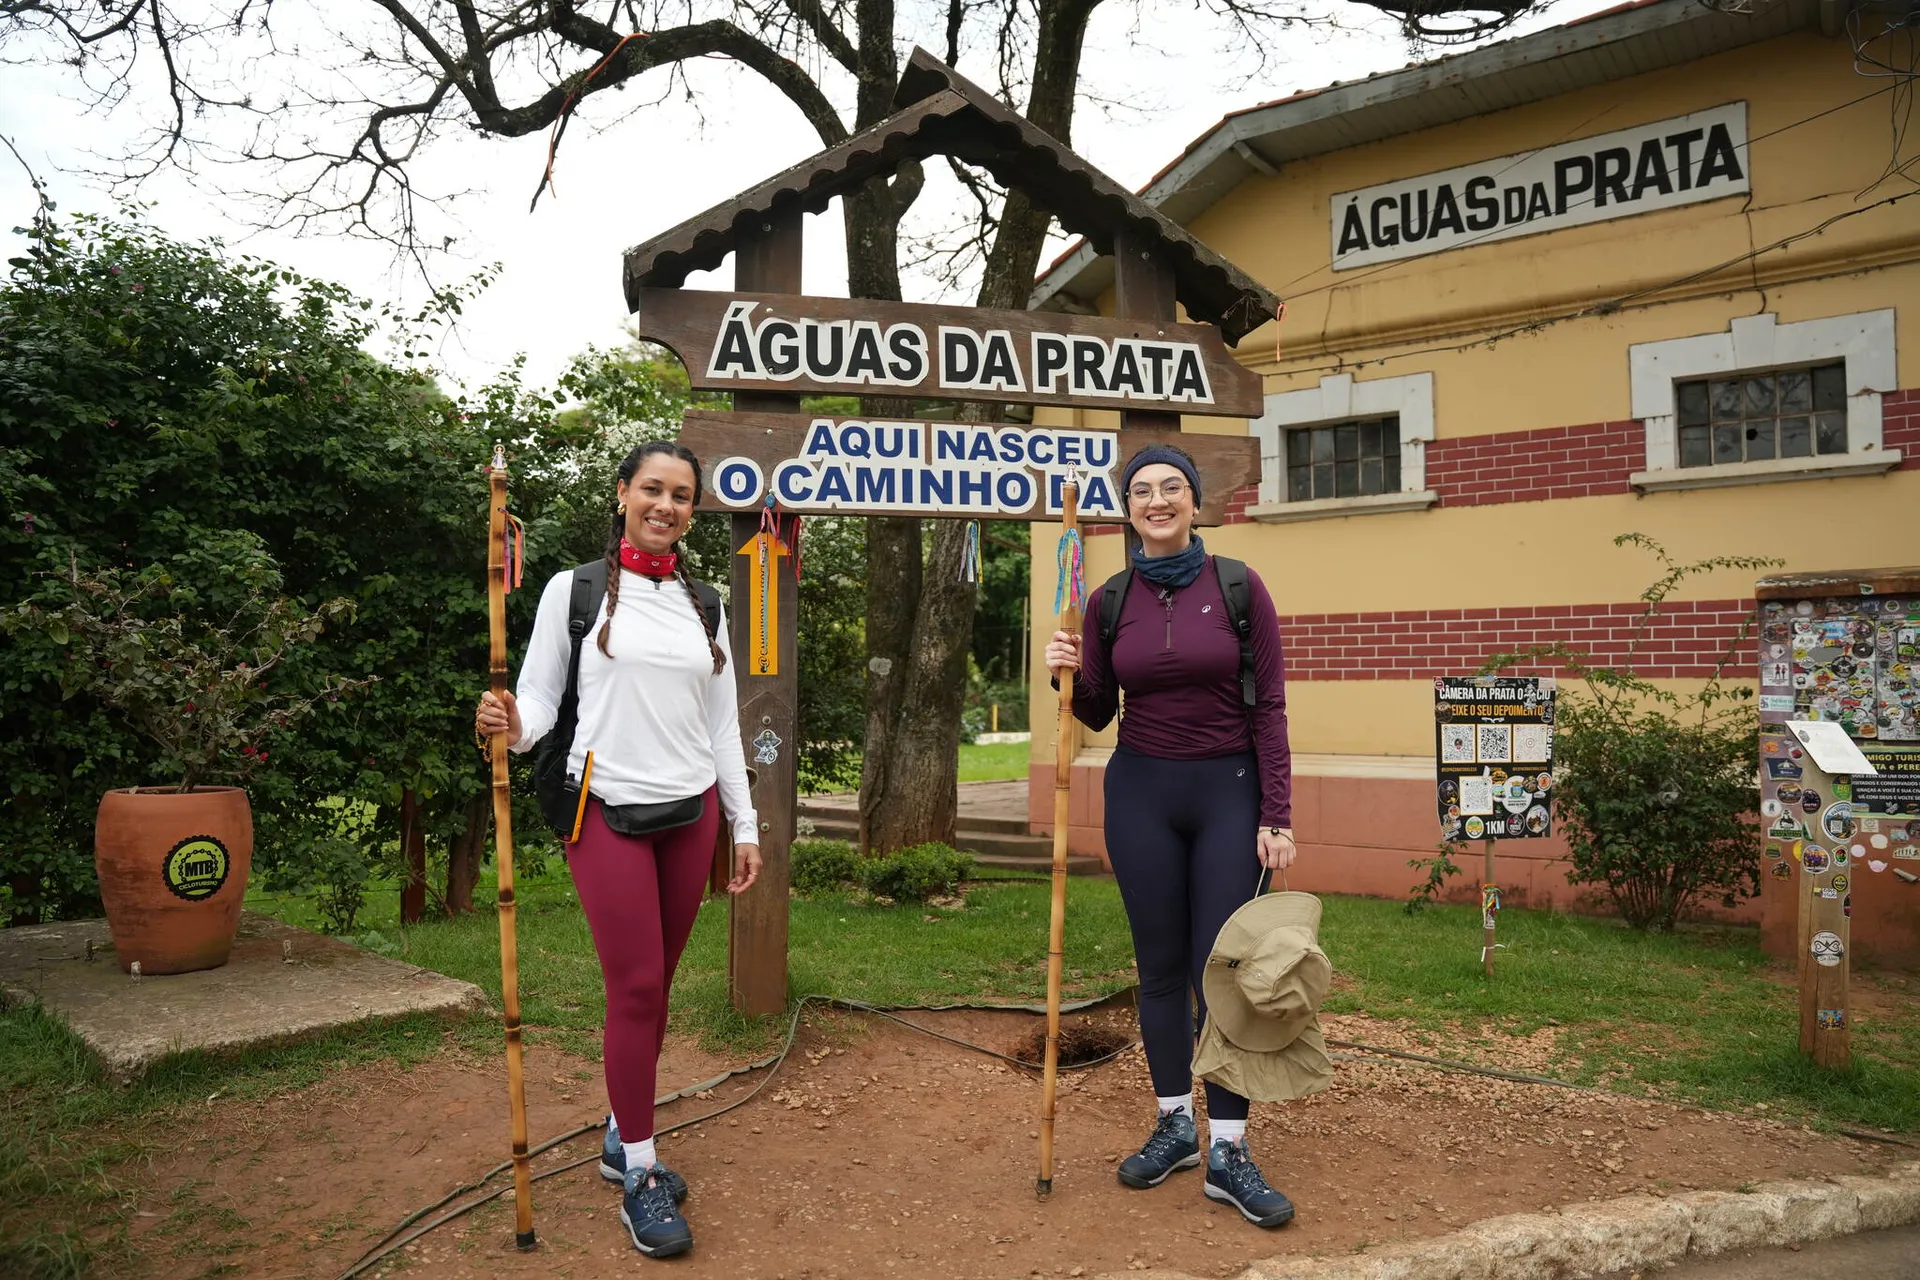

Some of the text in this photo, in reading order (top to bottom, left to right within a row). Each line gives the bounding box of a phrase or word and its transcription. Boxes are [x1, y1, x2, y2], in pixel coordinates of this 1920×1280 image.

[1336, 122, 1744, 257] ÁGUAS DA PRATA
[714, 304, 1209, 399] ÁGUAS DA PRATA
[808, 424, 1112, 466] AQUI NASCEU
[719, 463, 1114, 511] O CAMINHO DA
[1451, 704, 1543, 717] EIXE O SEU DEPOIMENTO
[1476, 688, 1487, 700] DA
[1489, 688, 1516, 700] PRATA
[184, 859, 214, 878] MTB
